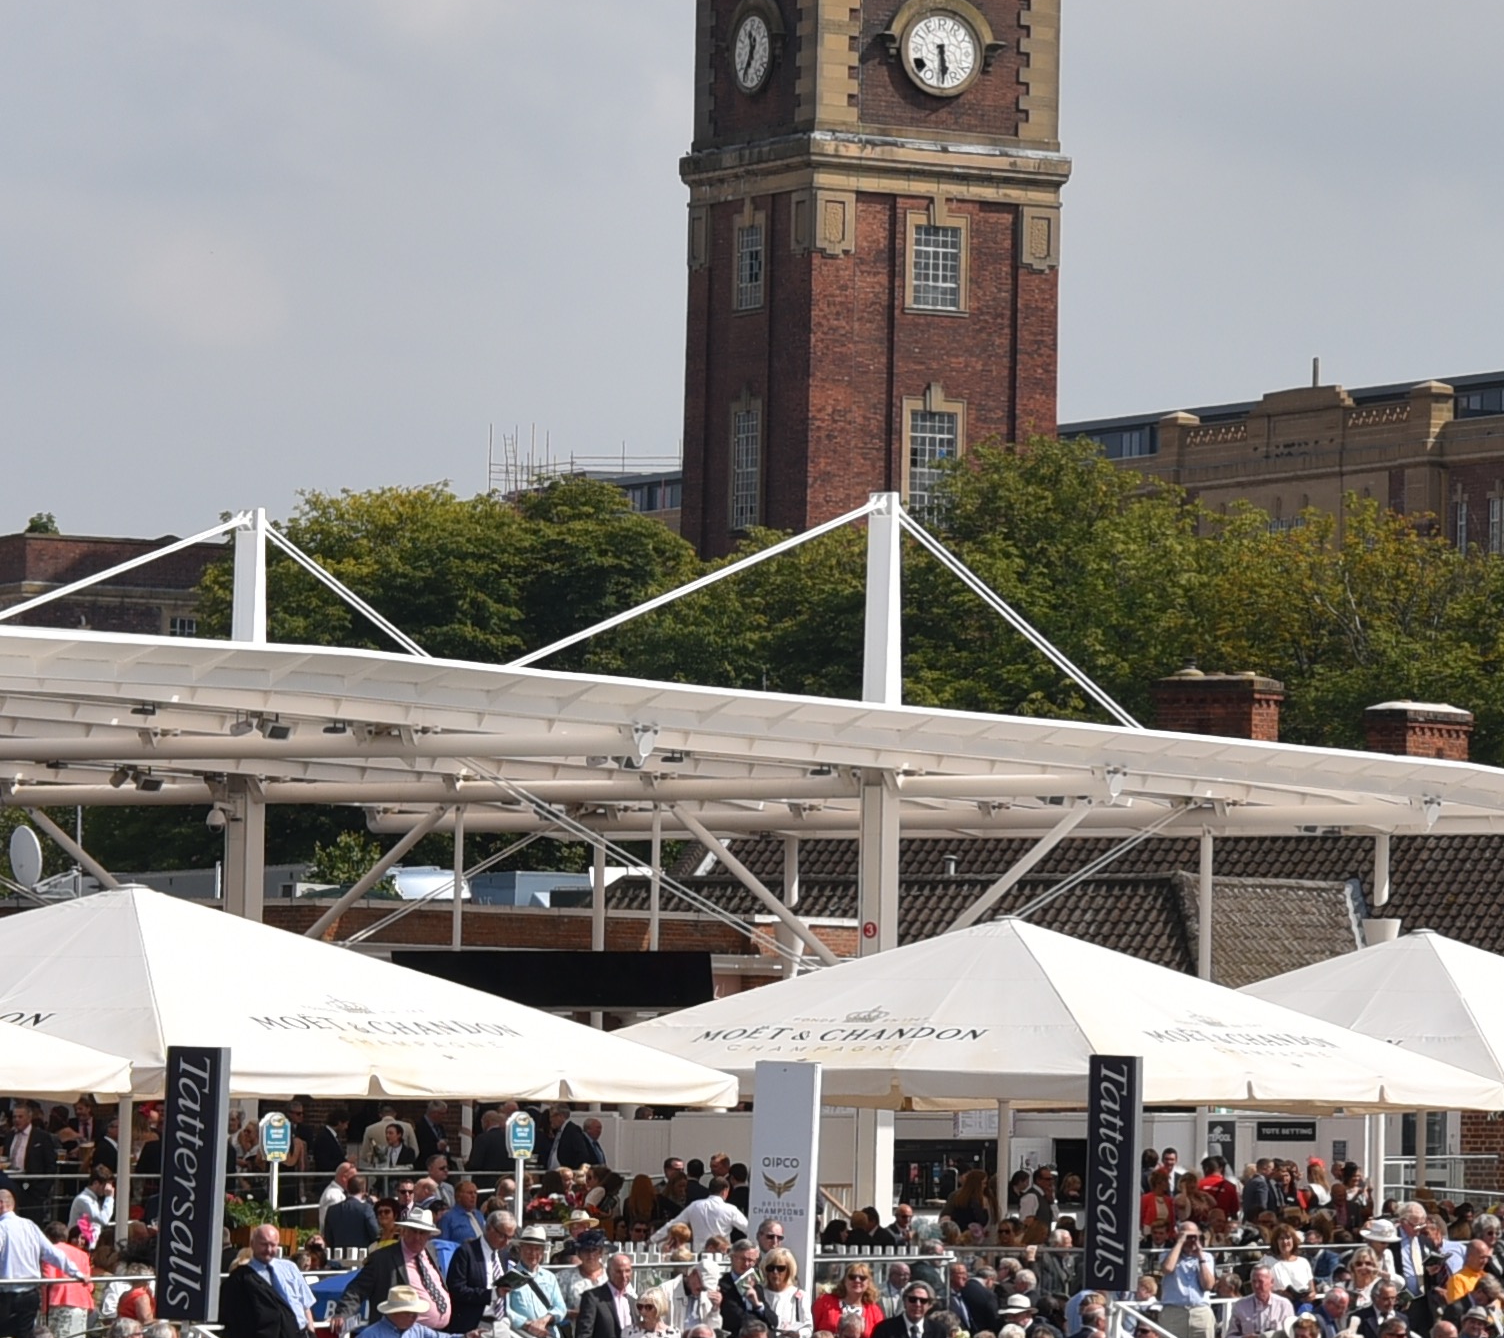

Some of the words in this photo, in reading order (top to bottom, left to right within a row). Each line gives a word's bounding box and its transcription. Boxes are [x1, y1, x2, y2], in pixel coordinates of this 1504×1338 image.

[912, 17, 971, 49] TERRY
[865, 923, 875, 937] 3
[691, 1024, 794, 1044] MOËT
[790, 1029, 812, 1041] &
[818, 1026, 989, 1042] CHANDON
[1261, 1127, 1280, 1135] TOTE
[1281, 1127, 1313, 1135] BETTING
[1093, 1062, 1129, 1283] Tattersalls
[166, 1055, 211, 1311] Tattersalls
[752, 1206, 806, 1216] CHAMPIONS
